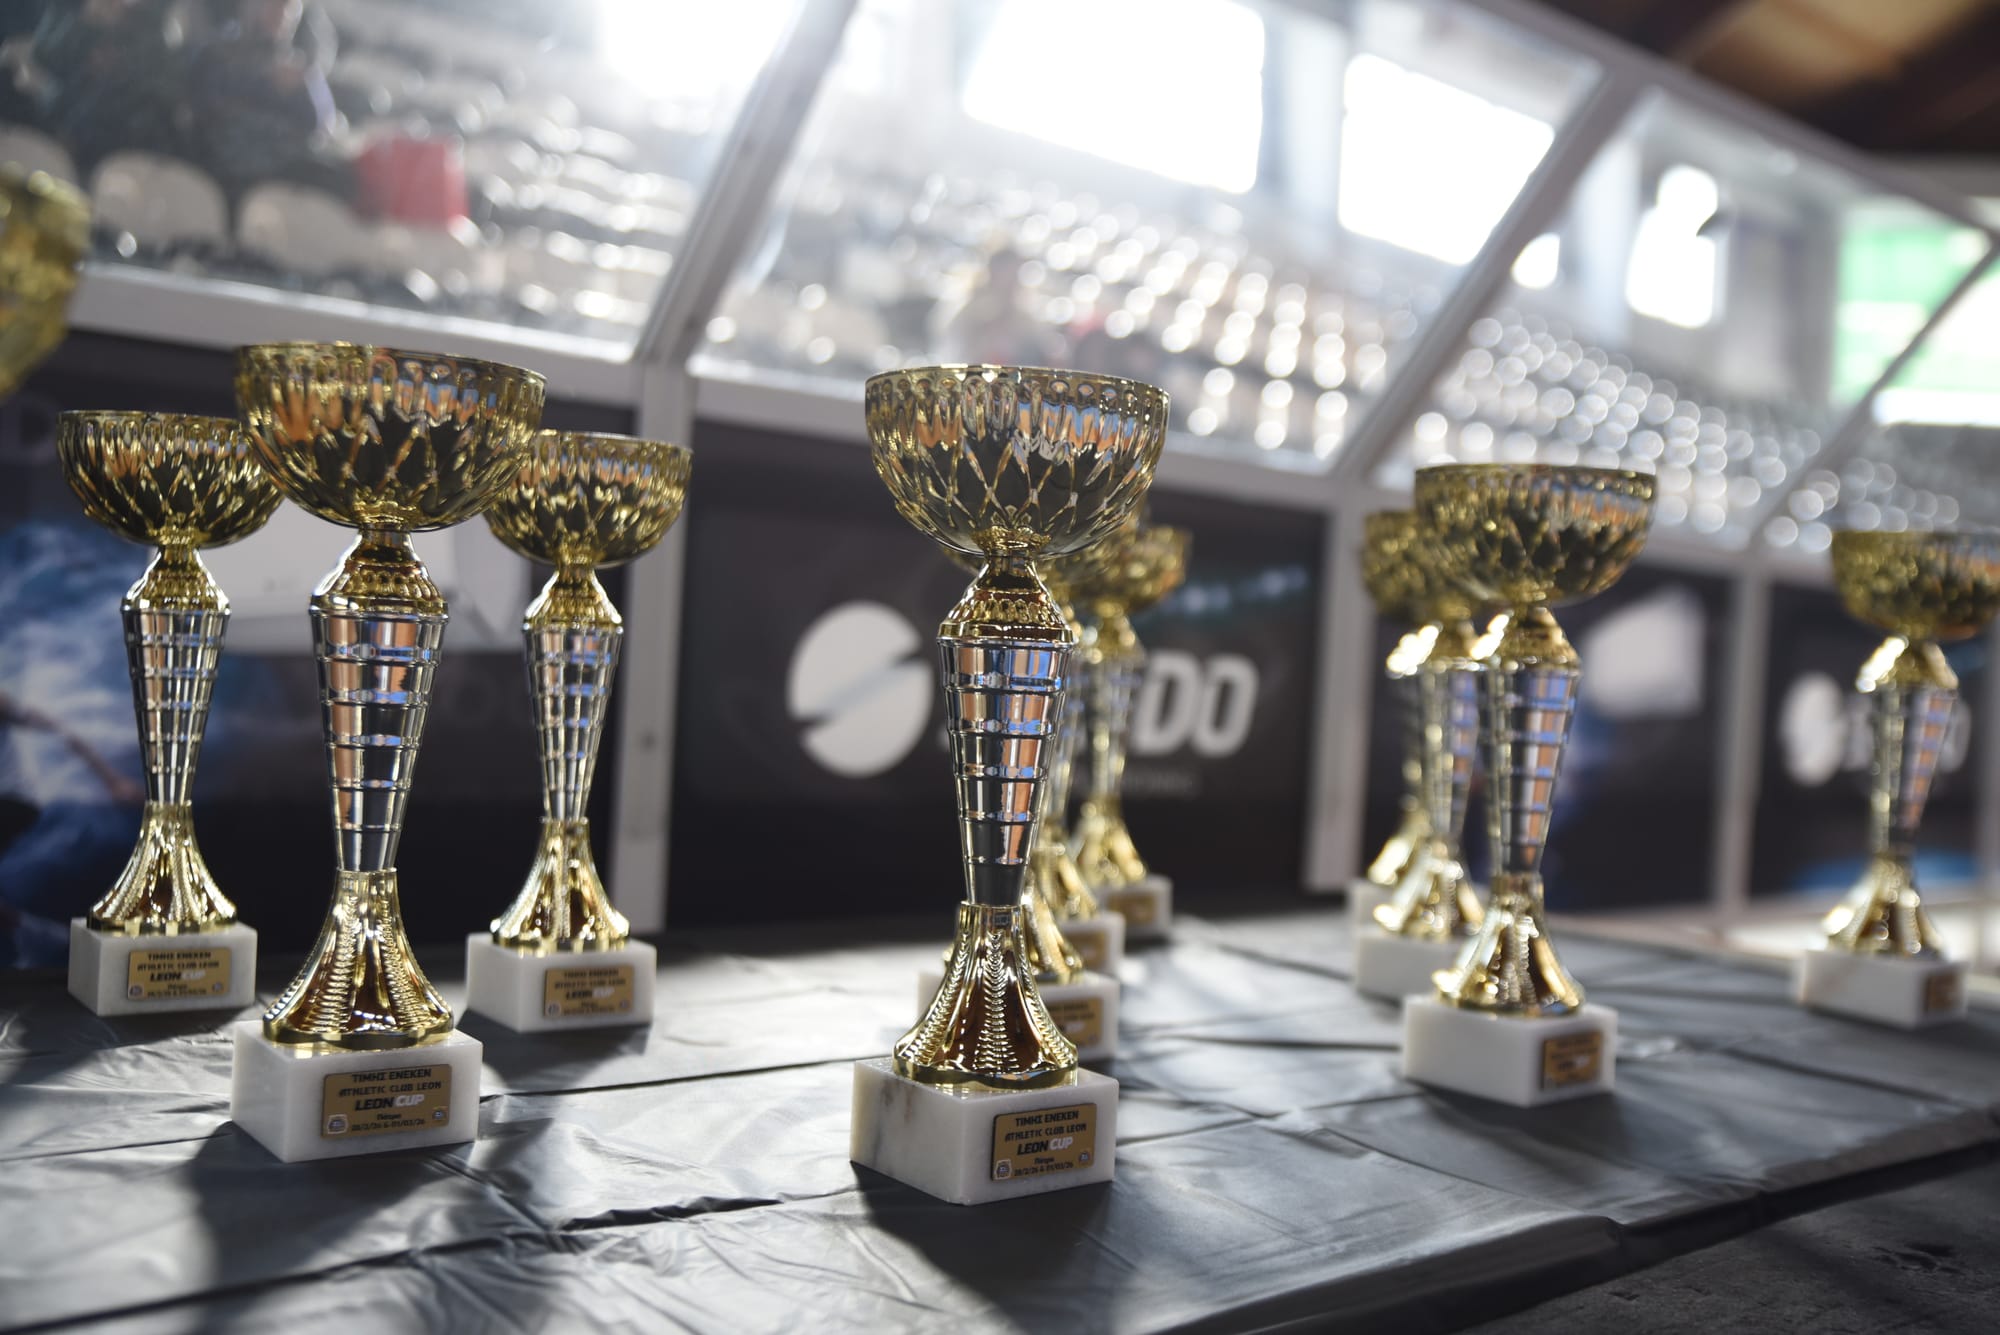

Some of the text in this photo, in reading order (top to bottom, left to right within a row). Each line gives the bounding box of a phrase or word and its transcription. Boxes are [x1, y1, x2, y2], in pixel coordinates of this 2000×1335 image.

[338, 1081, 442, 1097] ATHLETIC CLUB LEON
[354, 1094, 425, 1111] LEON CUP
[1005, 1123, 1087, 1142] ATHLETIC CLUB LEON
[1017, 1136, 1073, 1155] LEON CUP
